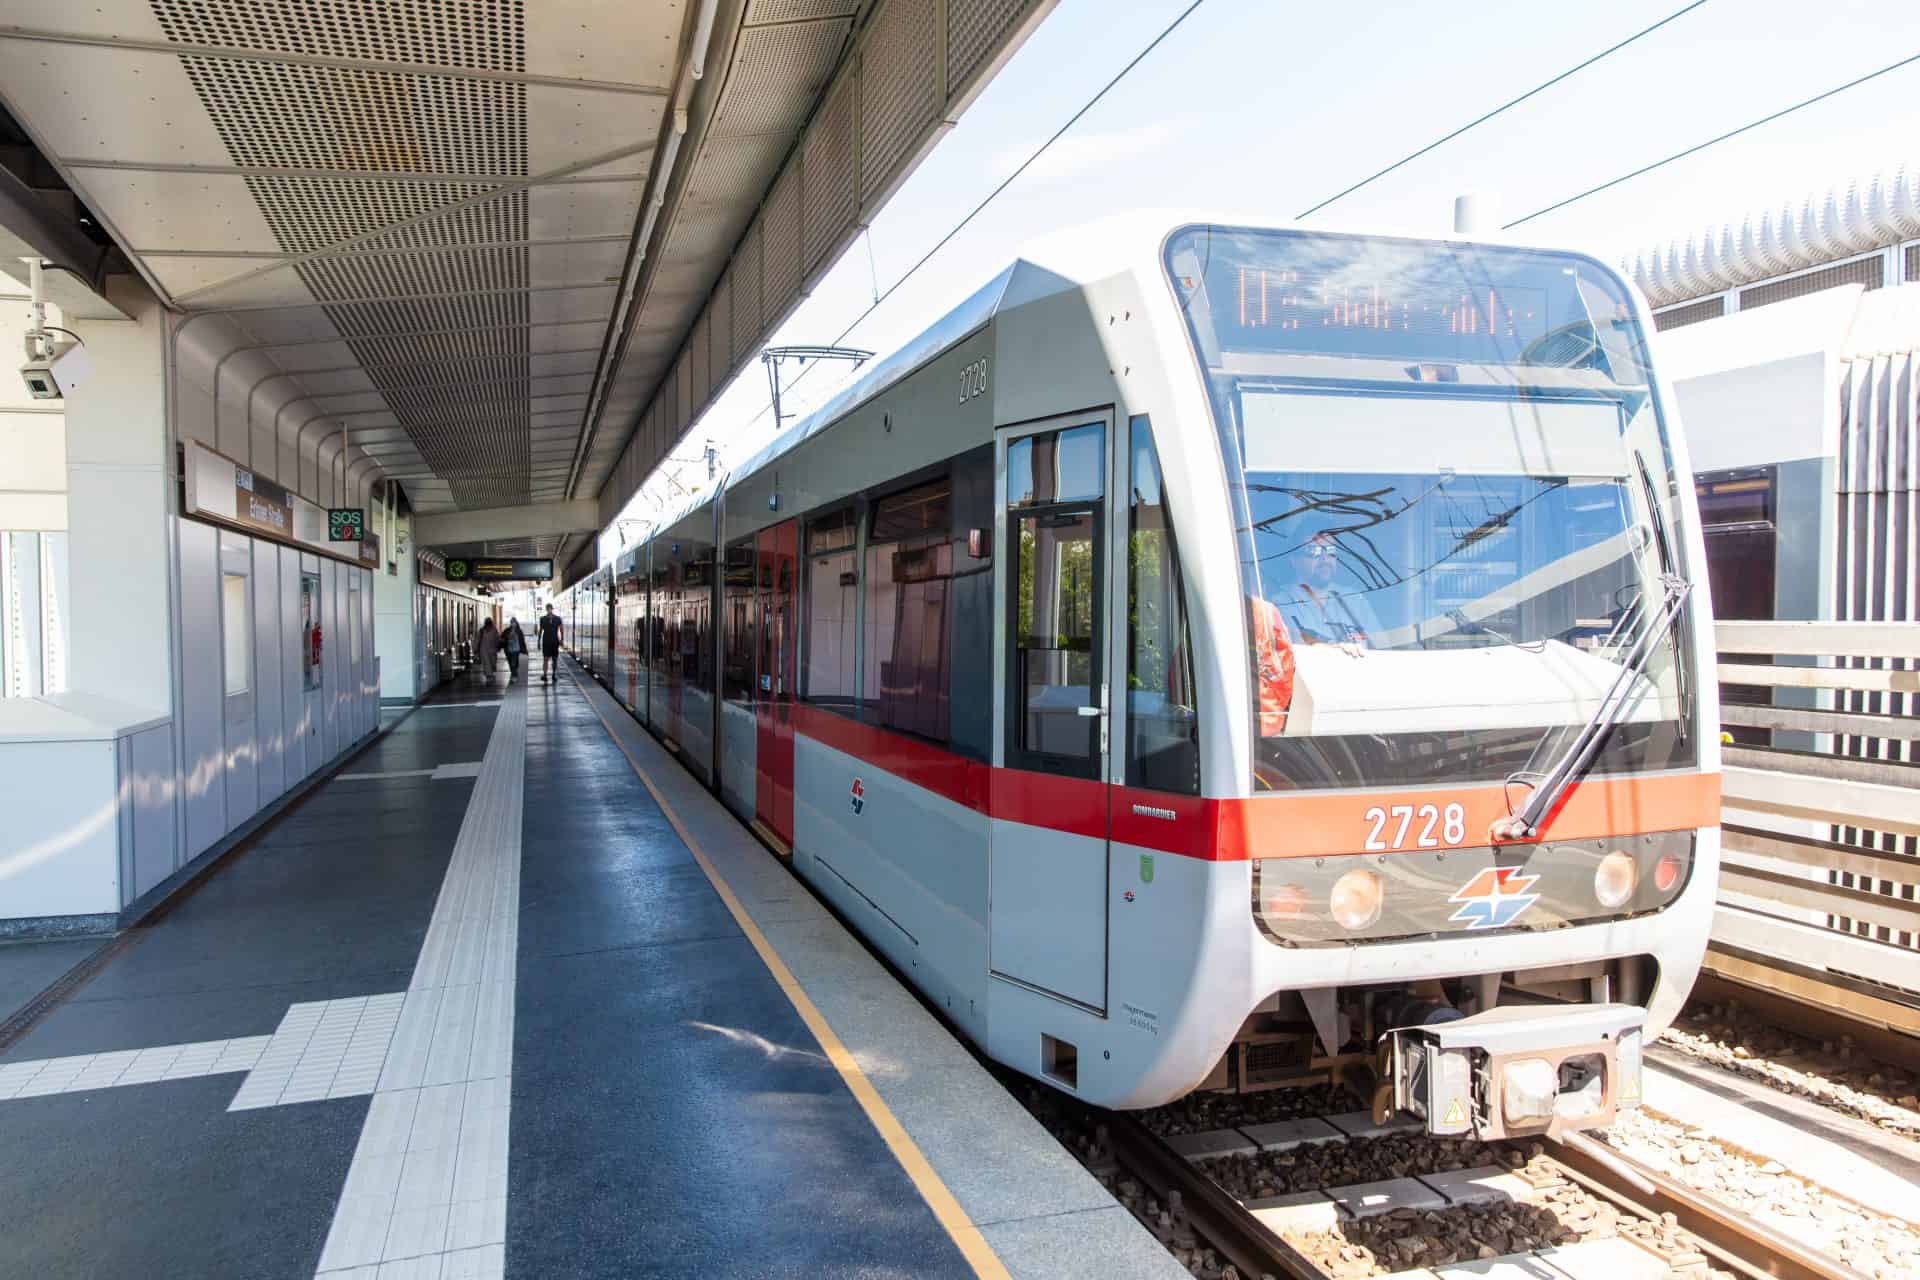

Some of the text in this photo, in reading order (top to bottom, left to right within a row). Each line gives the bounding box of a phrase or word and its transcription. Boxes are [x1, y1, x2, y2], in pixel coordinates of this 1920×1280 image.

[960, 359, 987, 403] 2728
[331, 511, 361, 525] SOS
[1364, 802, 1465, 850] 2728
